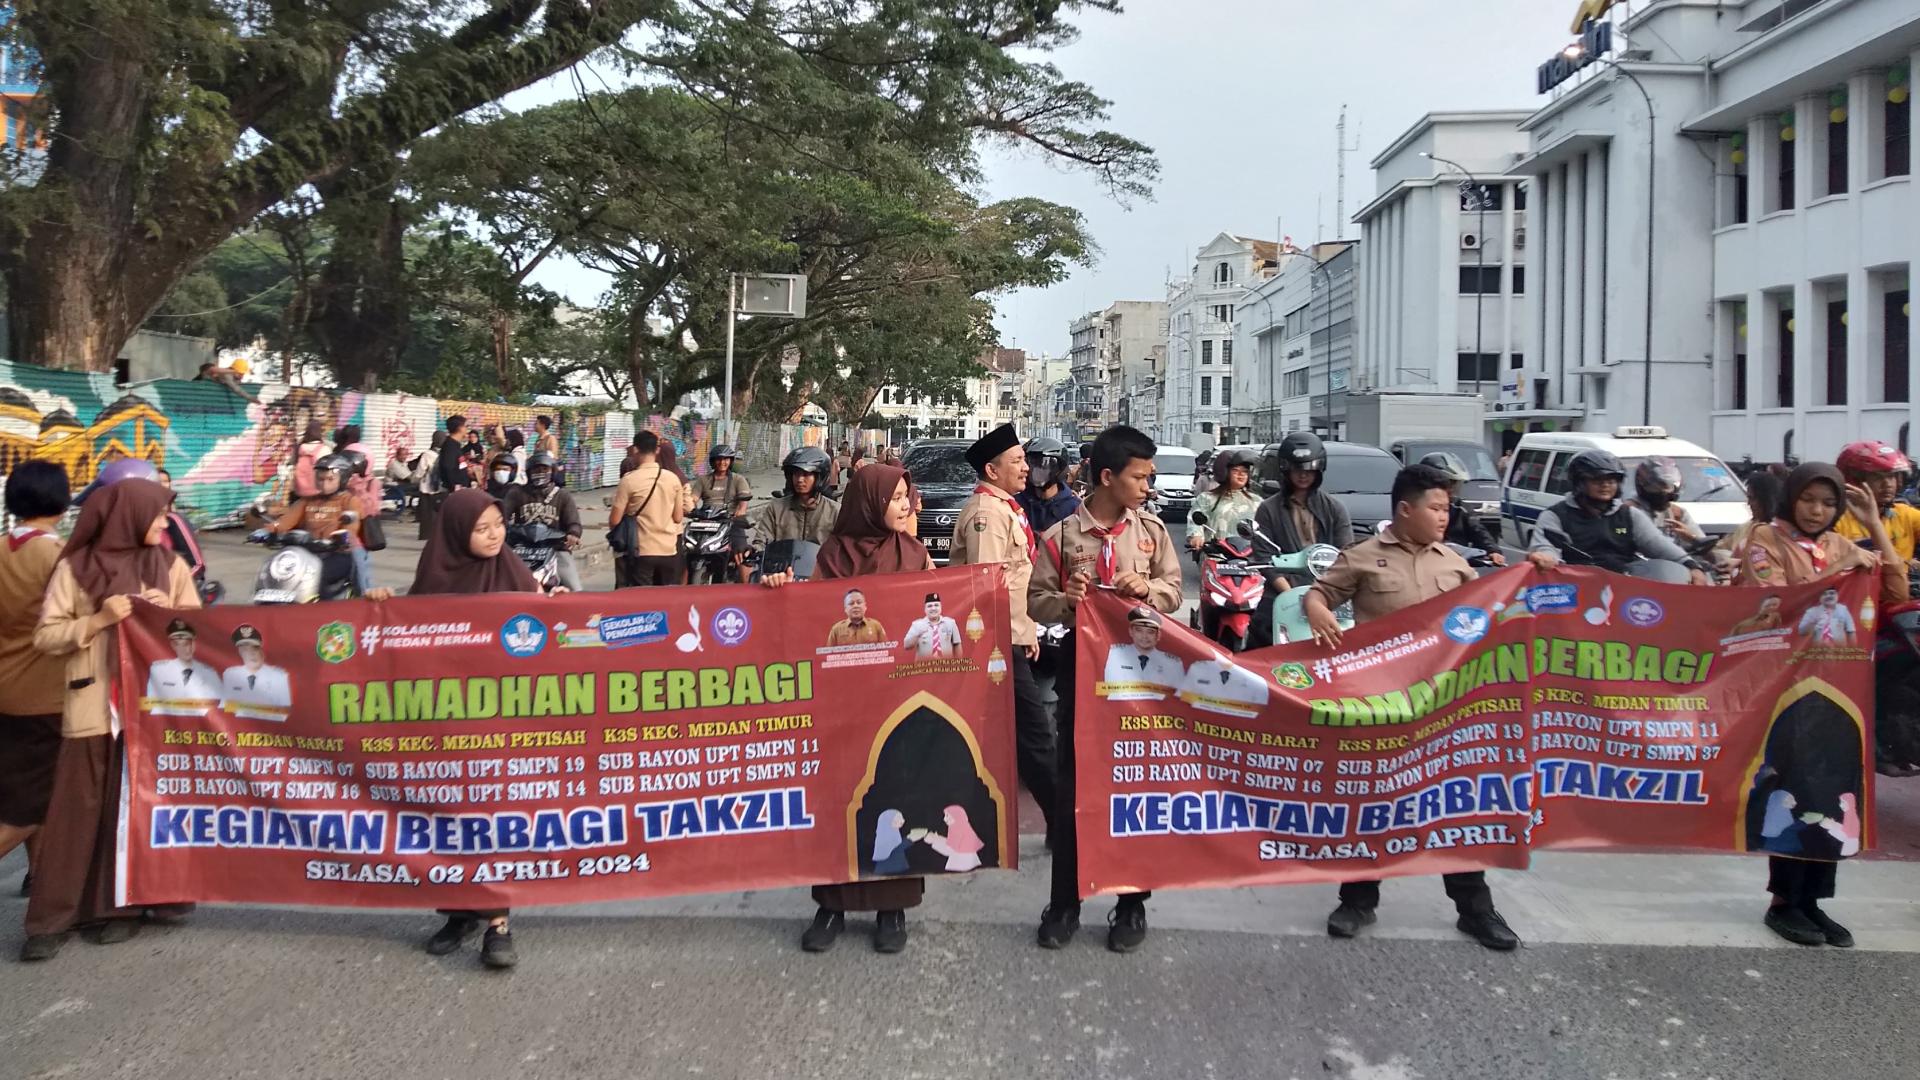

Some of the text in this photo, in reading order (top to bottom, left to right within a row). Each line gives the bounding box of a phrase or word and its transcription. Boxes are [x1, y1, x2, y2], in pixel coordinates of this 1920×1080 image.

[382, 622, 471, 636] KOLABORASI
[383, 631, 492, 648] MEDAN BERKAH
[1332, 632, 1414, 665] KOLABORASI
[1336, 635, 1439, 675] MEDAN BERKAH
[329, 660, 814, 724] RAMADHAN BERBAGI
[1309, 637, 1716, 727] RAMADHAN BERBAGI
[1547, 689, 1587, 706] KEC.
[1594, 695, 1651, 712] MEDAN
[1654, 696, 1709, 711] TIMUR
[603, 714, 813, 743] K3S KEC. MEDAN TIMUR
[1121, 715, 1319, 750] K3S KEC. MEDAN BARAT
[1541, 710, 1603, 732] RAYON
[1607, 718, 1642, 738] UPT
[1645, 720, 1695, 738] SMPN
[1699, 722, 1719, 738] 11
[163, 729, 344, 752] K3S KEC. MEDAN BARAT
[361, 730, 587, 752] K3S KEC. MEDAN PETISAH
[598, 738, 820, 772] SUB RAYON UPT SMPN 11
[1113, 738, 1324, 774] SUB RAYON UPT SMPN 07
[1337, 722, 1524, 776] SUB RAYON UPT SMPN 19
[1338, 739, 1372, 752] K3S
[1375, 735, 1410, 750] KEC.
[1540, 732, 1602, 753] RAYON
[1605, 740, 1643, 760] UPT
[1646, 744, 1697, 762] SMPN
[1701, 745, 1721, 761] 37
[157, 754, 353, 777] SUB RAYON UPT SMPN 07
[365, 756, 585, 780] SUB RAYON UPT SMPN 19
[599, 760, 821, 796] SUB RAYON UPT SMPN 37
[1112, 762, 1322, 794] SUB RAYON UPT SMPN 16
[1335, 746, 1527, 796] SUB RAYON UPT SMPN 14
[157, 778, 360, 801] SUB RAYON UPT SMPN 16
[370, 780, 586, 803] SUB RAYON UPT SMPN 14
[1110, 790, 1350, 838] KEGIATAN
[1356, 772, 1533, 835] BERBAG
[1537, 757, 1708, 805] TAKZIL
[151, 787, 815, 856] KEGIATAN BERBAGI TAKZIL
[1259, 840, 1378, 860] SELASA,
[1386, 835, 1417, 854] 02
[1424, 825, 1516, 850] APRIL
[306, 853, 650, 886] SELASA, 02 APRIL 2024
